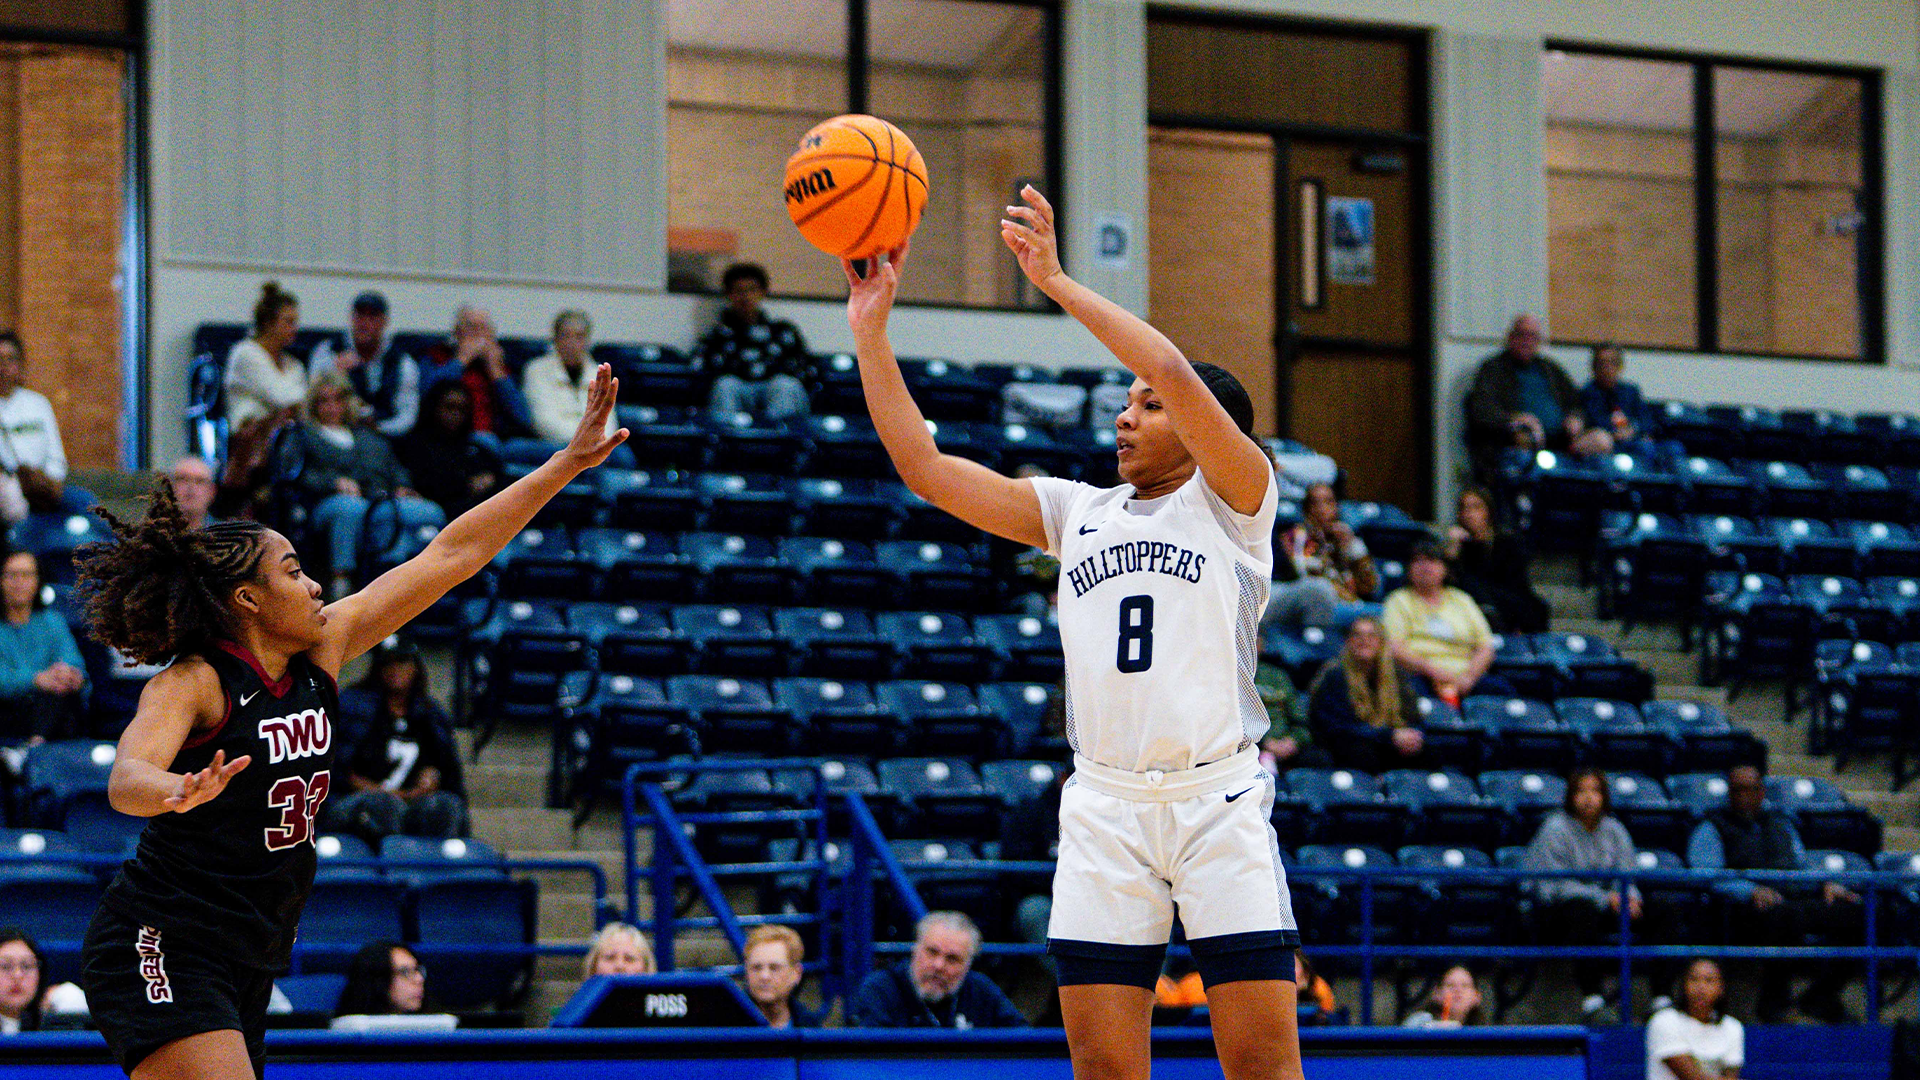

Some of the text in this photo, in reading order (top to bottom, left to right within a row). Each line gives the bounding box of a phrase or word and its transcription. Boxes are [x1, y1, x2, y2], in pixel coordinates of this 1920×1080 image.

[1101, 225, 1127, 257] D
[1067, 540, 1207, 598] HILLTOPPERS
[1116, 594, 1154, 674] 8
[258, 706, 332, 765] TWU
[381, 738, 420, 792] 7
[644, 993, 688, 1018] POSS
